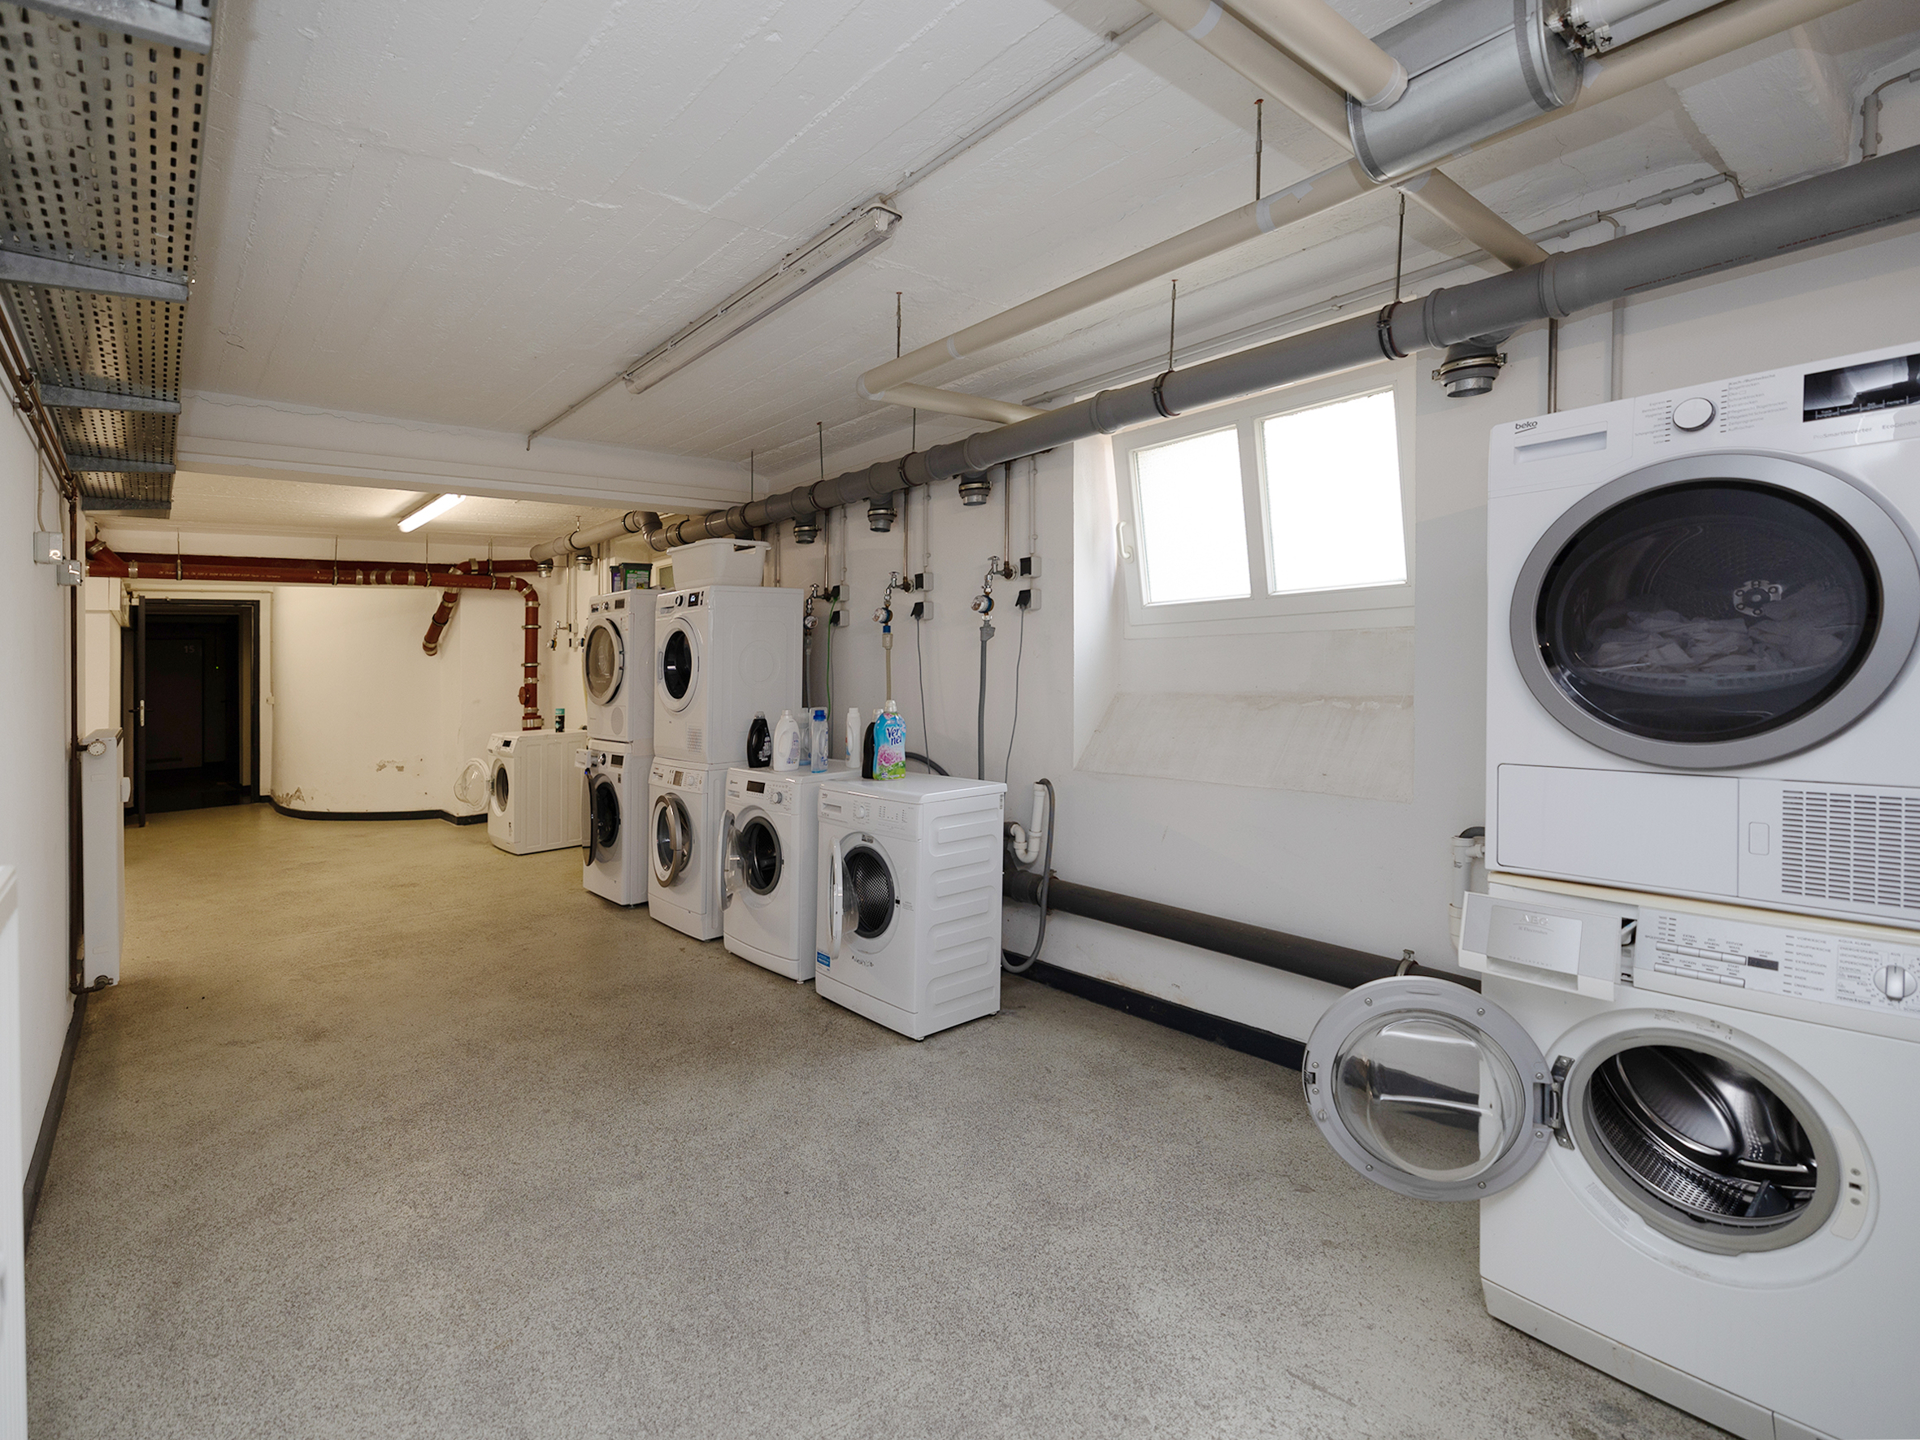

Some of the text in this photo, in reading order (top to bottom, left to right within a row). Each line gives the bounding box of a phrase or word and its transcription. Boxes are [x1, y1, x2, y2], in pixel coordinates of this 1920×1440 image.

[1514, 421, 1538, 431] beko
[183, 645, 195, 654] 15
[1519, 913, 1549, 926] AEG
